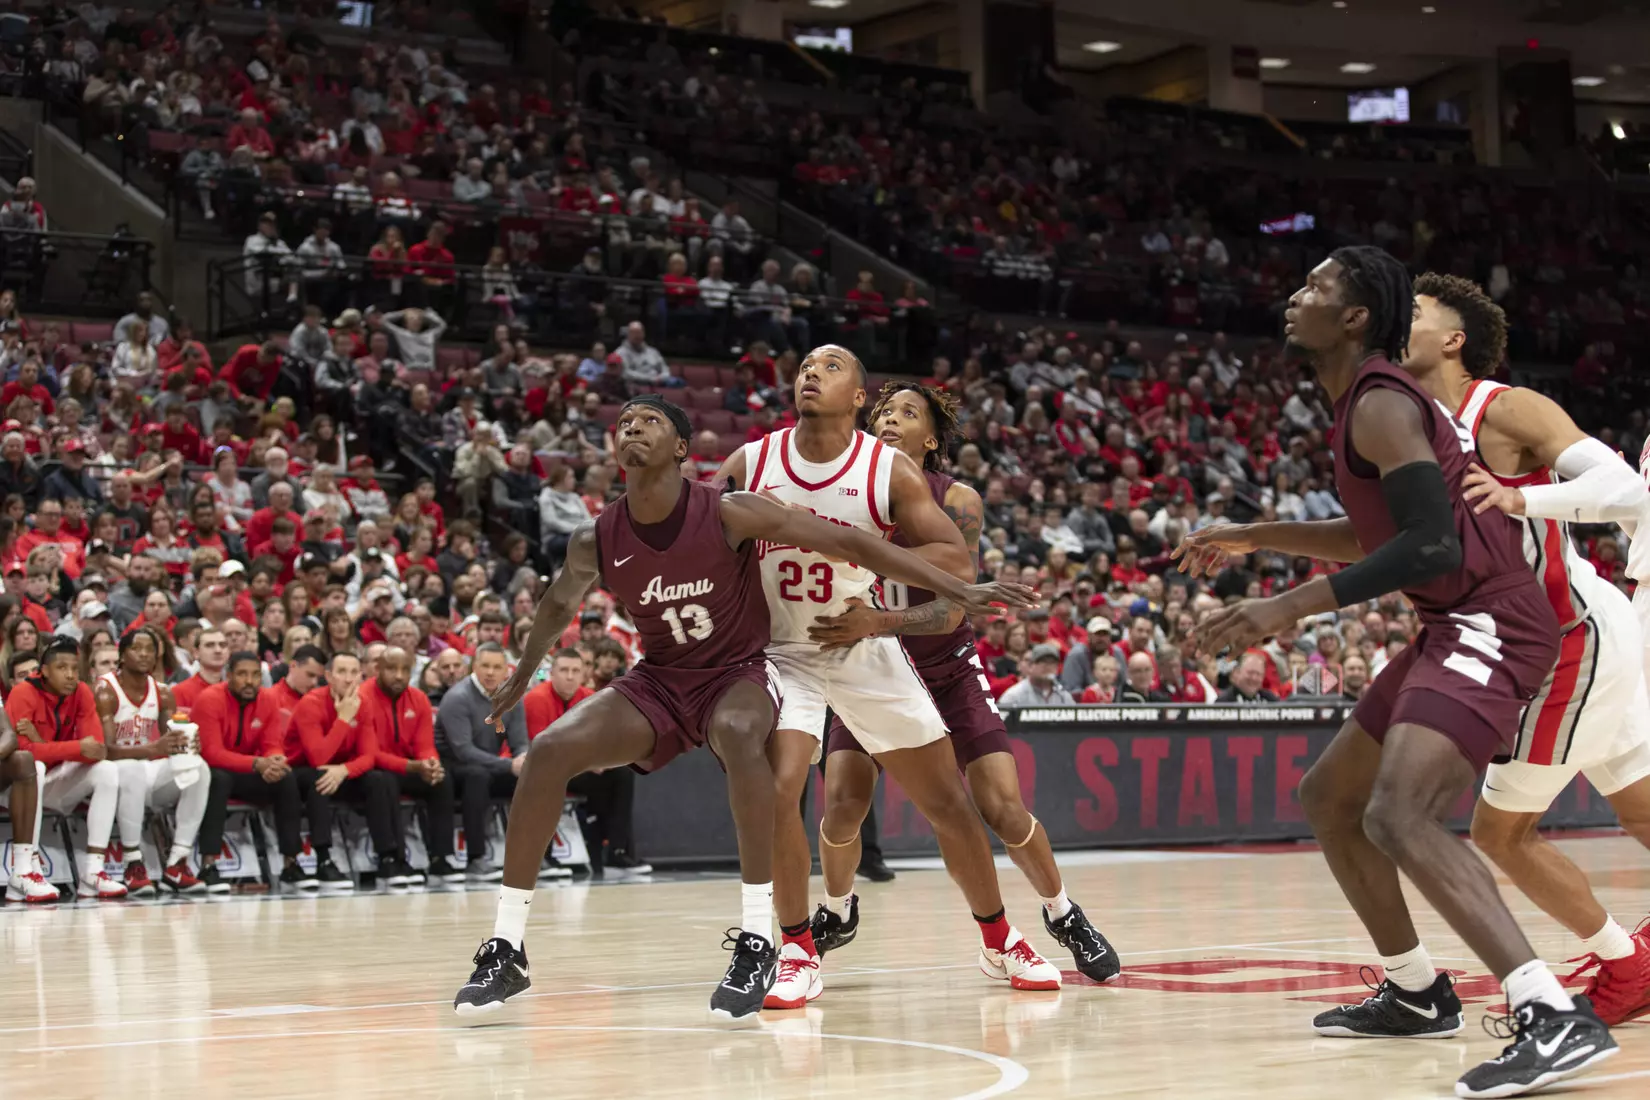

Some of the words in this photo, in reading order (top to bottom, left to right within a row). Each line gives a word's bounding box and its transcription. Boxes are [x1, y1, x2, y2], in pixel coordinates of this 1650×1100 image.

[639, 575, 714, 605] Aamu
[778, 560, 833, 603] 23
[661, 604, 714, 644] 13
[1020, 709, 1075, 722] AMERICAN
[1077, 709, 1120, 721] ELECTRIC
[1122, 709, 1158, 721] POWER
[1187, 708, 1238, 721] AMERICAN
[1240, 708, 1279, 720] ELECTRIC
[1281, 708, 1315, 720] POWER
[1074, 734, 1309, 832] STATE
